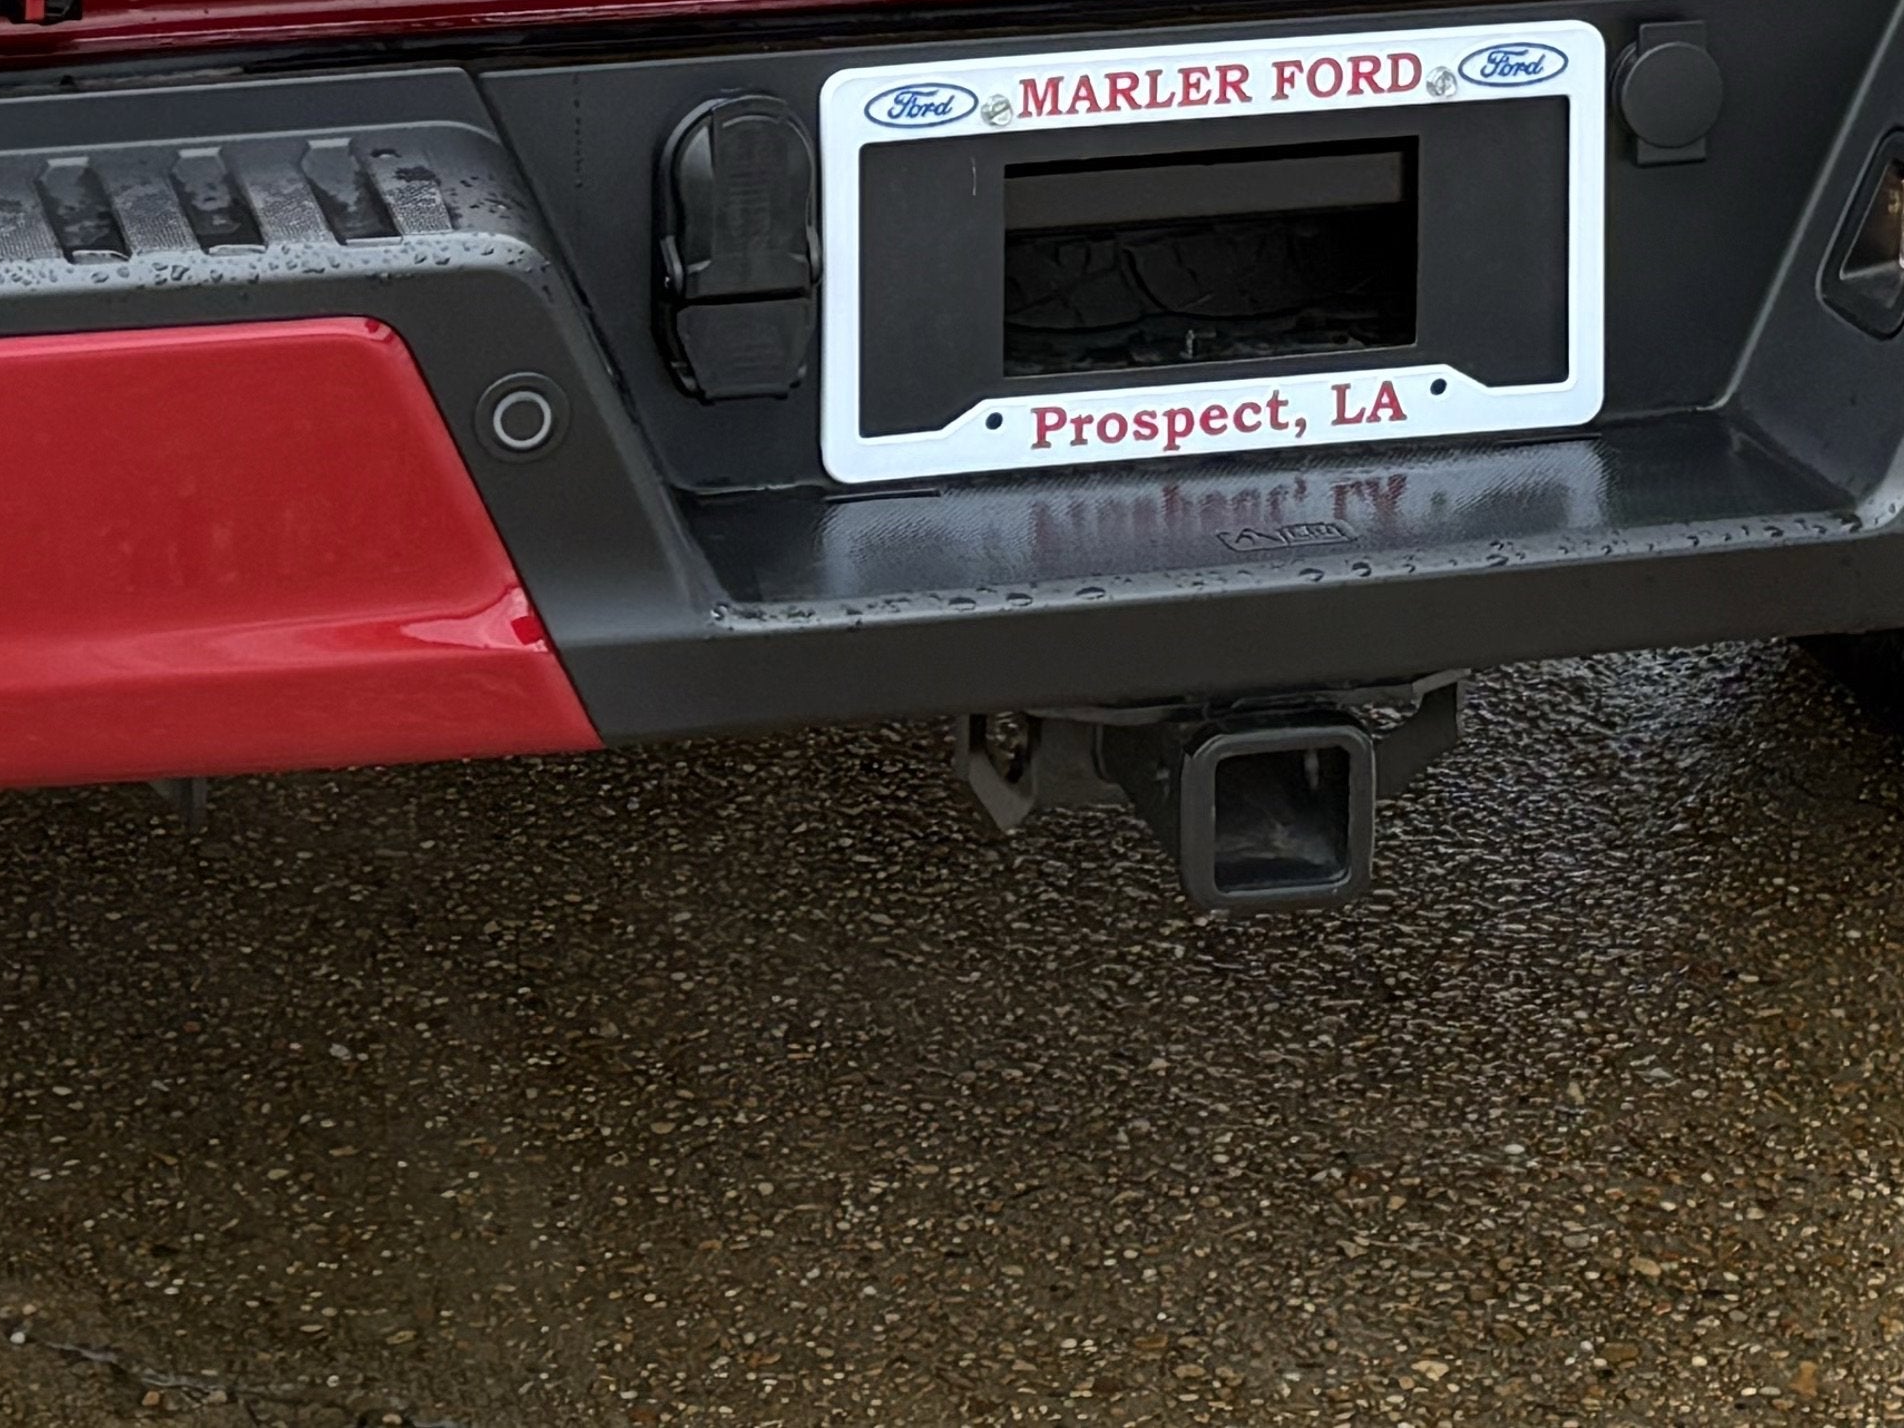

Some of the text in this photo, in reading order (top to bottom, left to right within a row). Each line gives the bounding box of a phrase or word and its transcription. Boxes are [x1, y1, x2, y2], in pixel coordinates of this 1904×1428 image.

[1017, 52, 1423, 119] MARLER FORD
[1030, 380, 1408, 452] Prospect, LA
